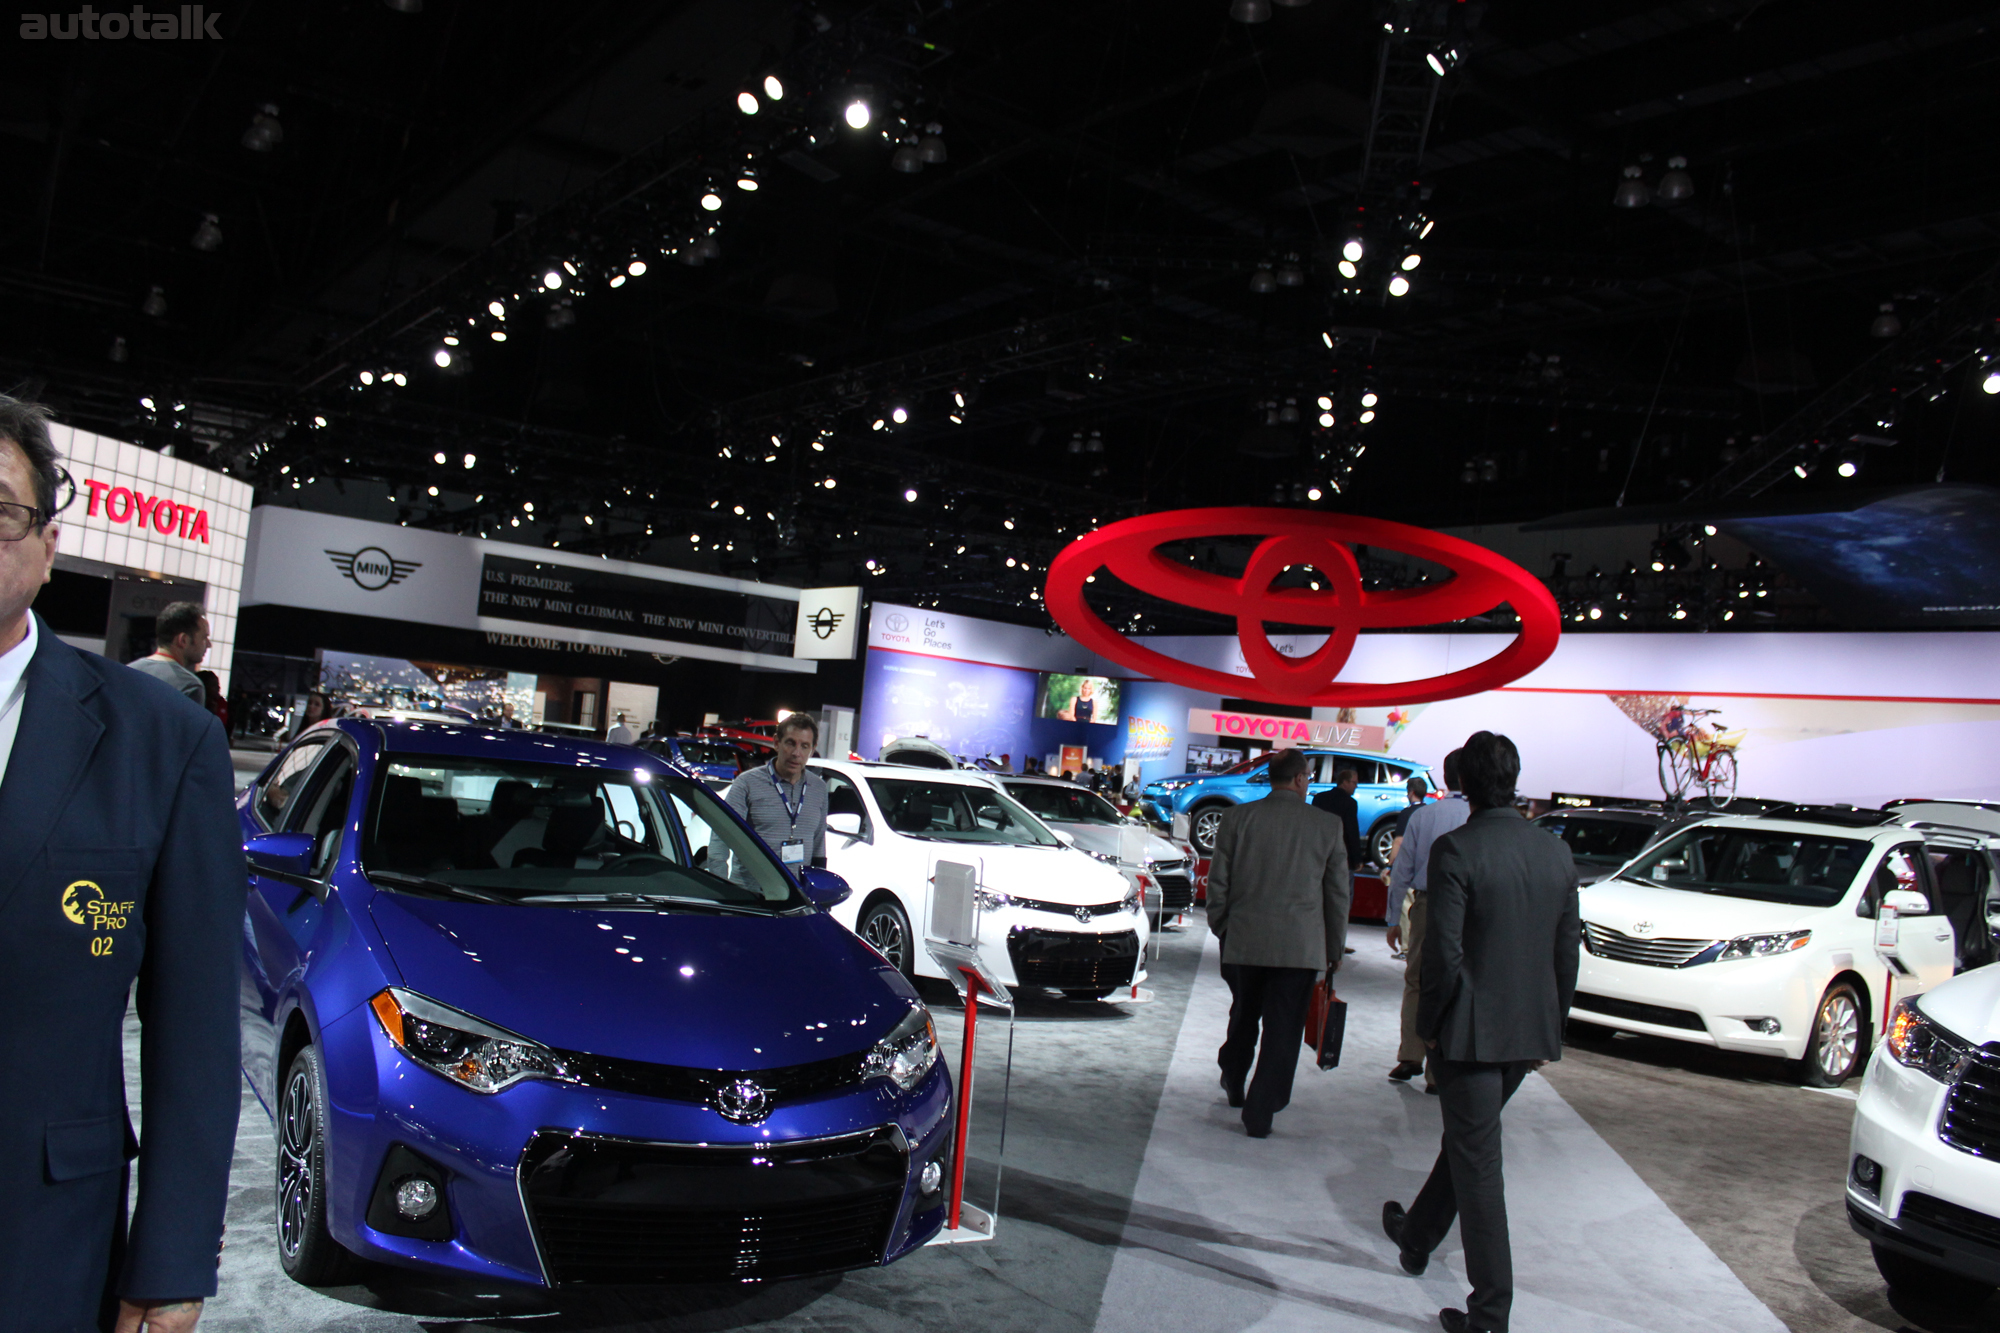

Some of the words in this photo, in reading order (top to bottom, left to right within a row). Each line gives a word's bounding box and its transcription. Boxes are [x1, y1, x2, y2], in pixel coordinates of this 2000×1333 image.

[84, 479, 209, 545] TOYOTA
[356, 561, 389, 577] MINI
[510, 573, 574, 592] PREMIERE.
[483, 591, 509, 605] THE
[511, 595, 541, 609] NEW
[544, 599, 573, 614] MINI
[575, 604, 635, 623] CLUBMAN.
[642, 612, 665, 627] THE
[668, 616, 695, 630] NEW
[697, 621, 724, 635] MINI
[925, 617, 945, 629] Let's
[881, 633, 910, 643] TOYOTA
[923, 628, 937, 638] Go
[485, 632, 561, 650] WELCOME
[923, 638, 952, 651] Places
[1235, 666, 1251, 674] TOY
[1128, 716, 1164, 735] BACK
[1211, 714, 1310, 741] TOYOTA
[1313, 725, 1363, 746] LIVE
[1135, 735, 1174, 748] FUTURE
[86, 900, 135, 915] STAFF
[93, 915, 127, 930] PRO
[91, 936, 114, 957] 02
